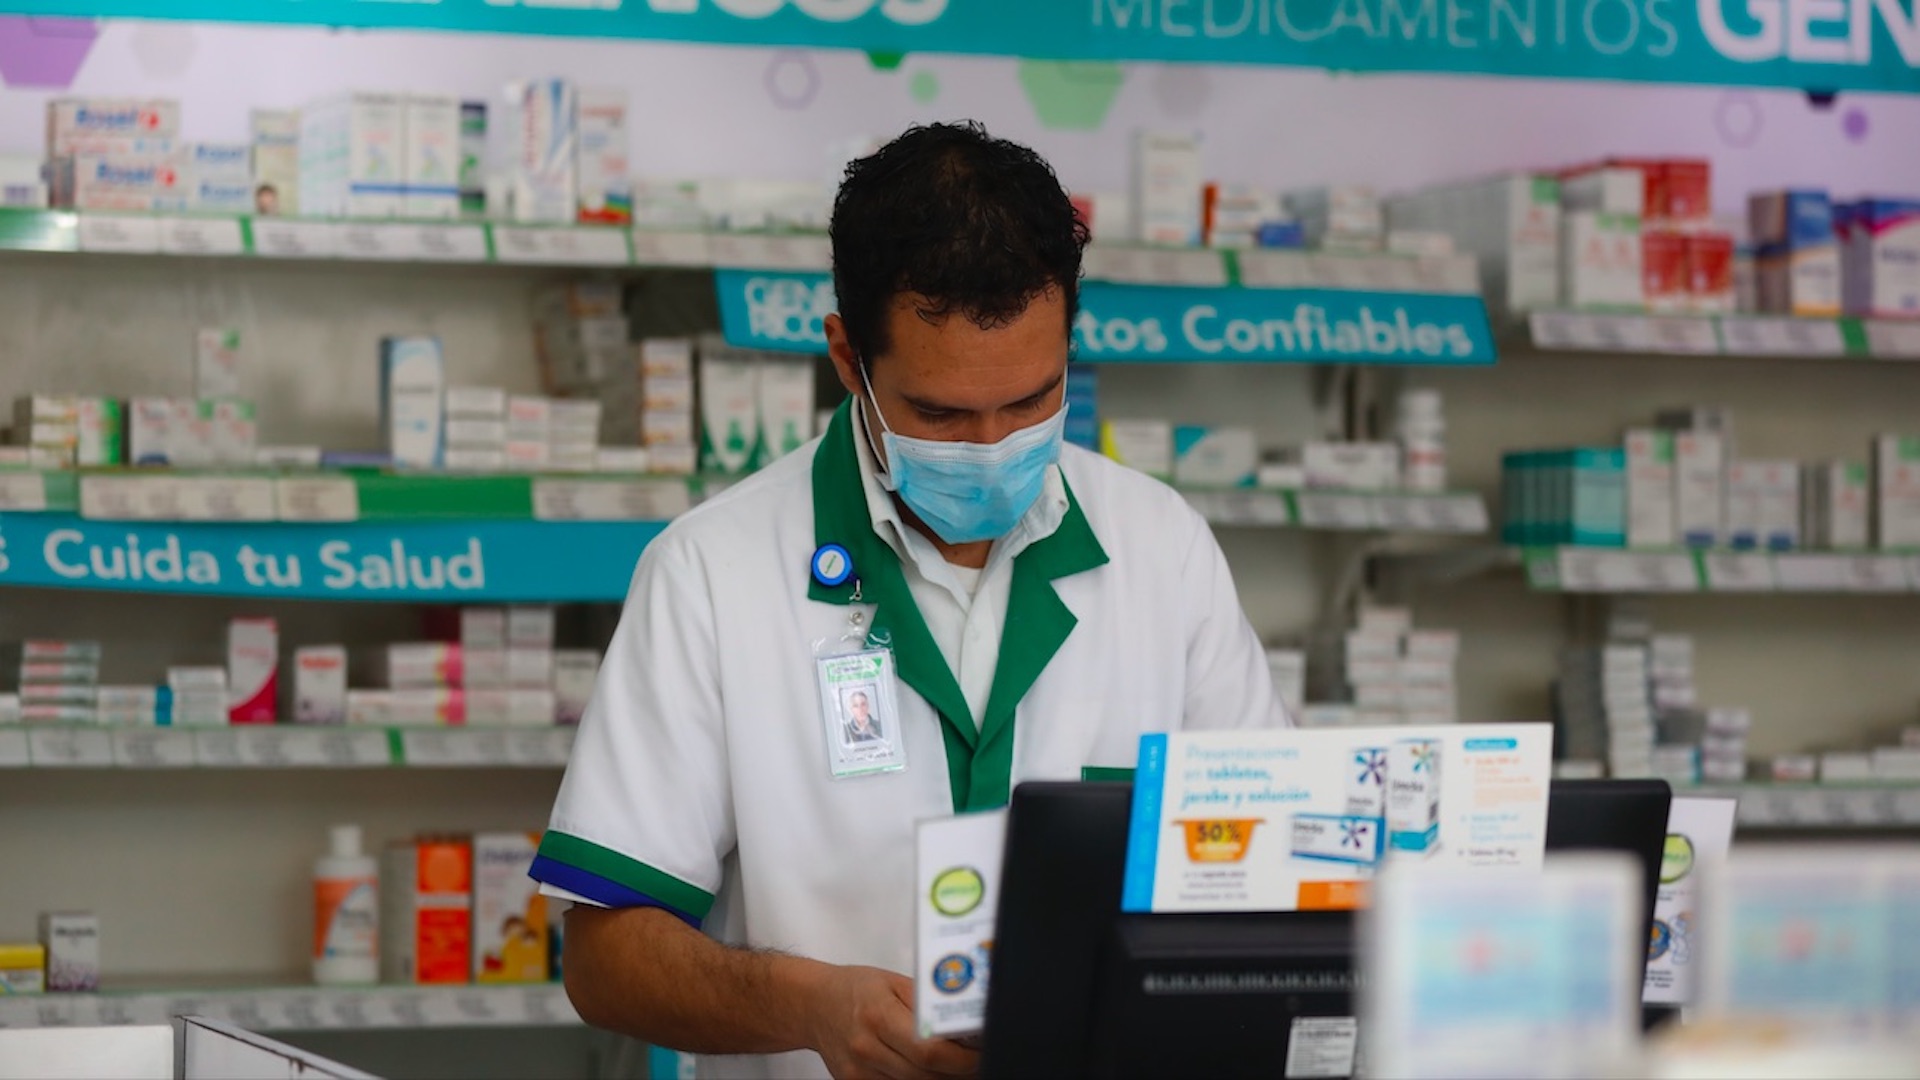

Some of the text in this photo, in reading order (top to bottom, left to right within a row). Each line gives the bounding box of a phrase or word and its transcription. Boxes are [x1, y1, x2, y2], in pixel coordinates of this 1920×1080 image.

[1181, 302, 1473, 357] Confiables
[43, 529, 221, 584] Cuida
[237, 544, 302, 588] tu
[318, 536, 486, 591] Salud
[1196, 821, 1241, 843] 50%
